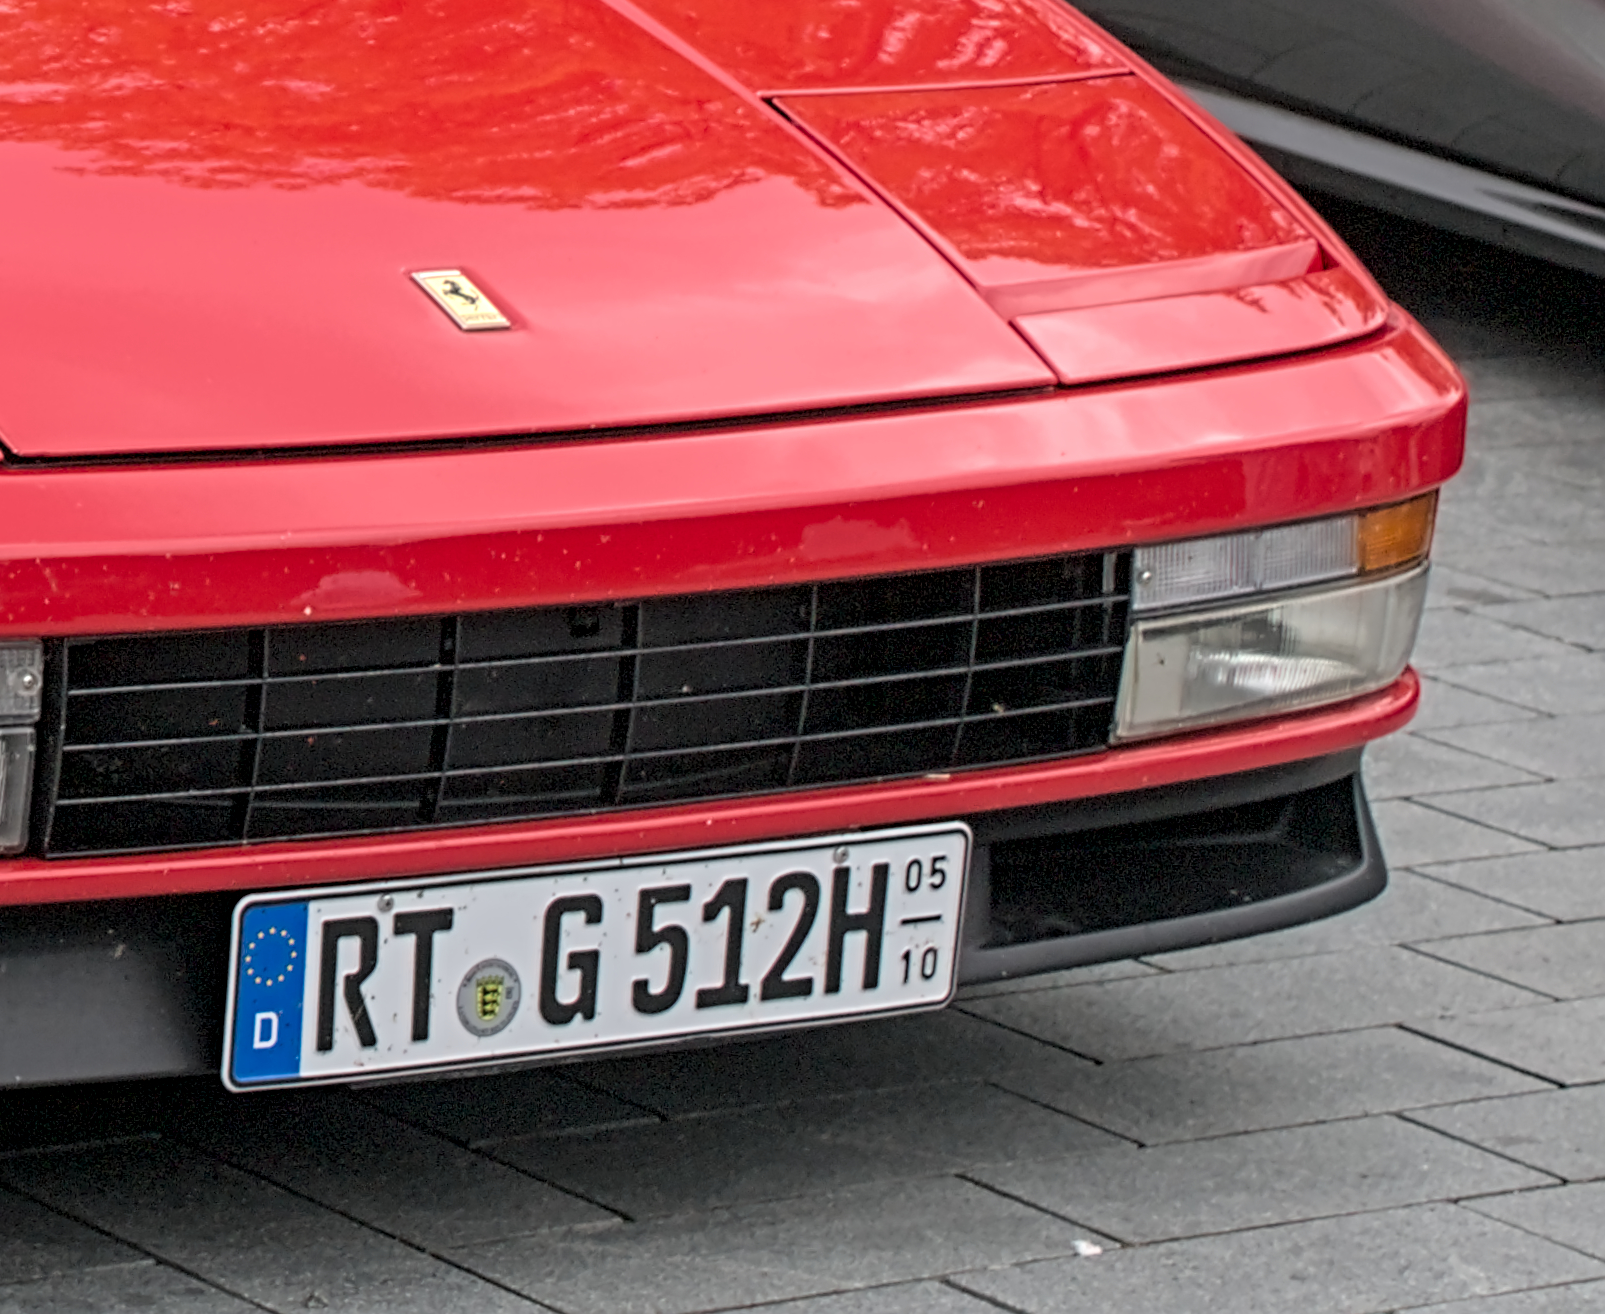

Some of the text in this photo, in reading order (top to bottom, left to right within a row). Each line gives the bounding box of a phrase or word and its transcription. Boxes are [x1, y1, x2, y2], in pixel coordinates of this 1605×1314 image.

[904, 855, 948, 893] 05
[315, 907, 453, 1052] RT
[537, 893, 604, 1026] G
[631, 860, 891, 1015] 512H
[900, 946, 938, 985] 10
[253, 1011, 278, 1049] D
